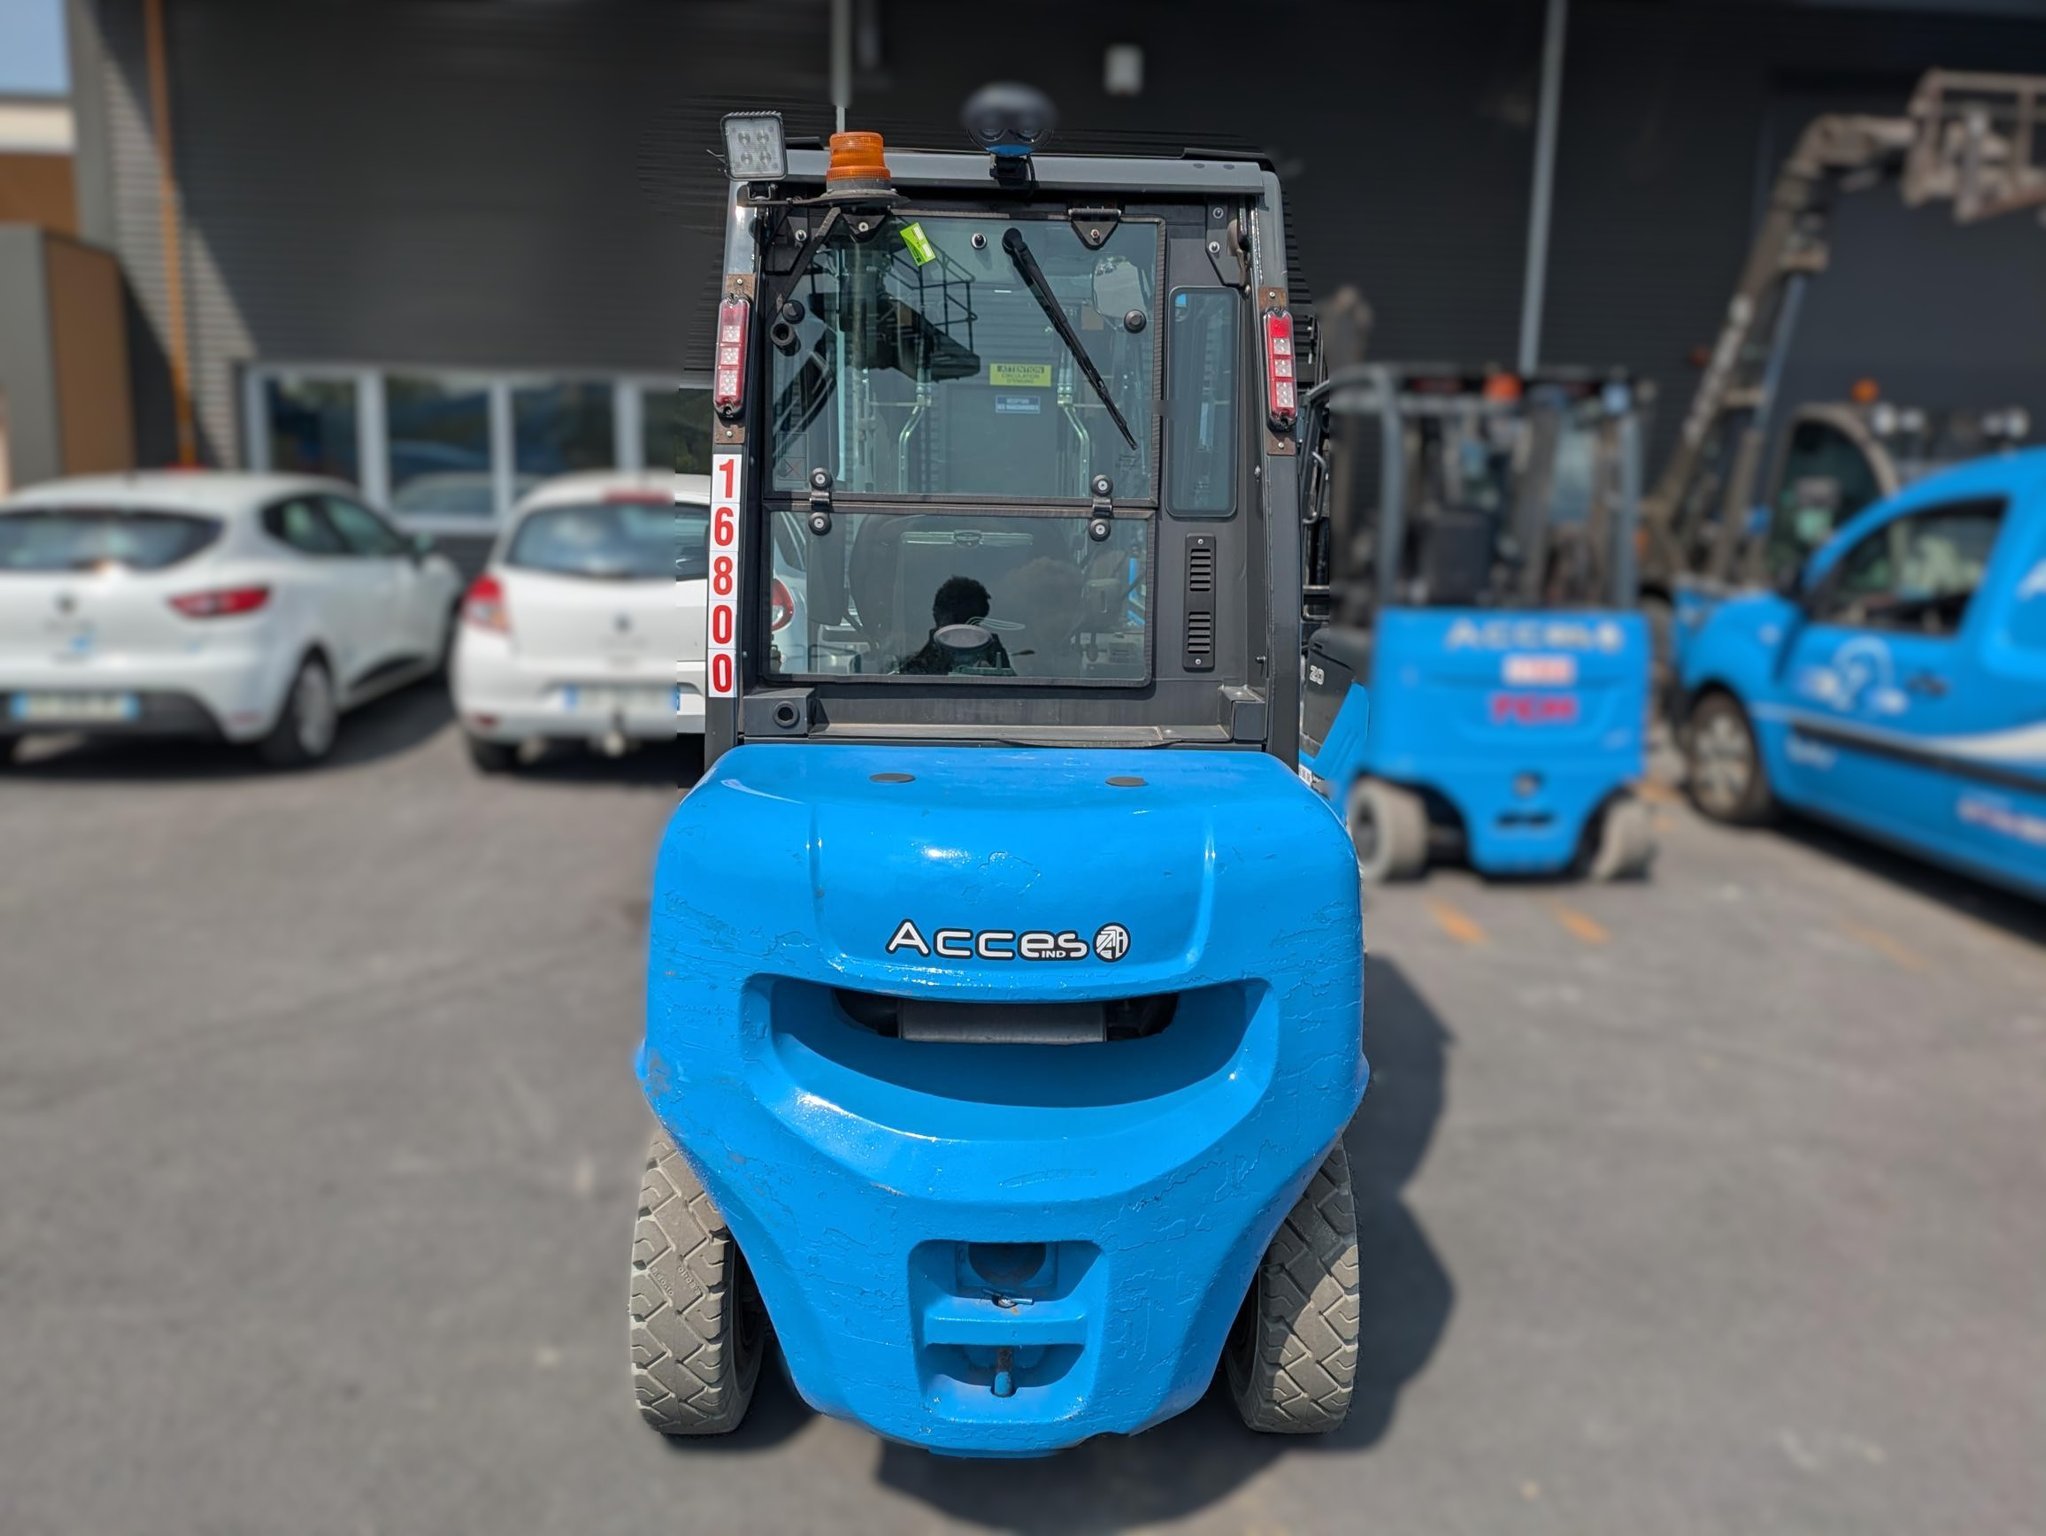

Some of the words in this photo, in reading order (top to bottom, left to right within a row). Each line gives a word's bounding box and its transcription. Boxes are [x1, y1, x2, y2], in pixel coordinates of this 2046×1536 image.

[713, 458, 734, 693] 16800
[886, 919, 1089, 960] Acces
[1041, 950, 1066, 958] IND
